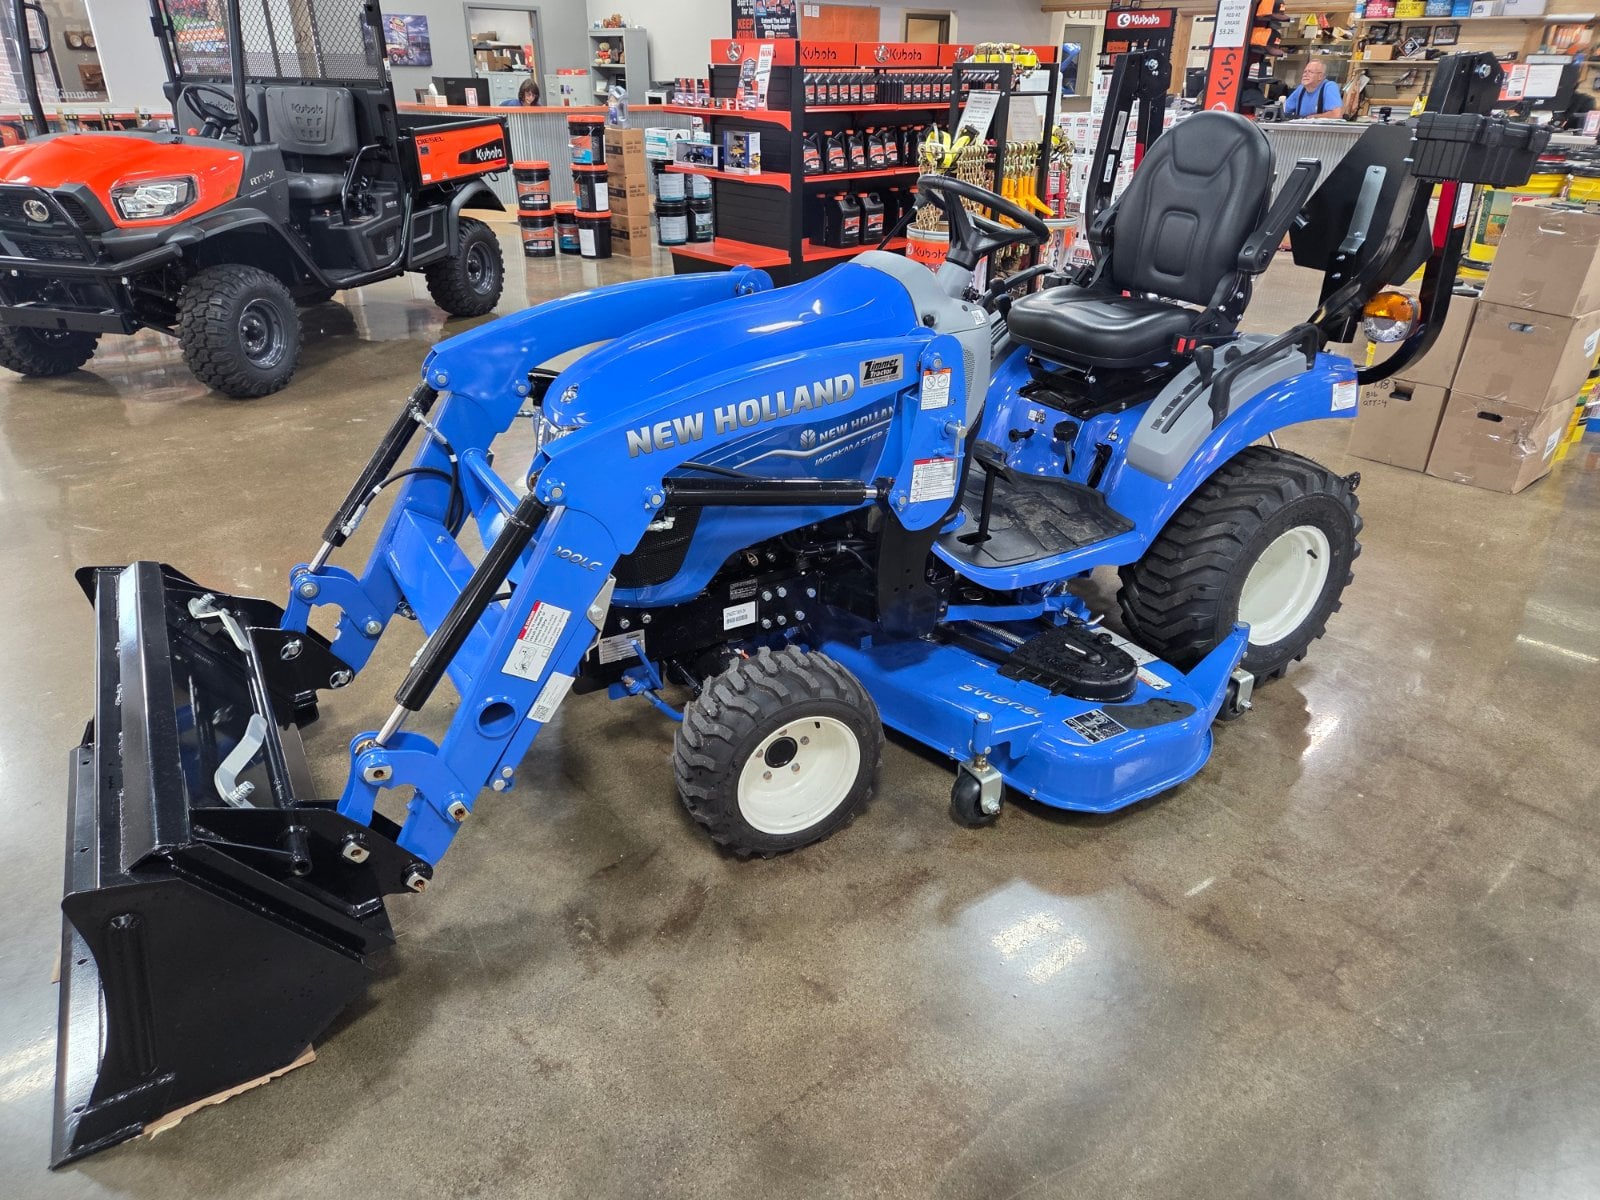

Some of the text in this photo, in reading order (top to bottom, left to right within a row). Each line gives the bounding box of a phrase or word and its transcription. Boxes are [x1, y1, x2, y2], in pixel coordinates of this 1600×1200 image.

[737, 19, 753, 29] KEEP
[1131, 14, 1160, 25] Kubota
[800, 45, 837, 59] Kubota
[889, 45, 922, 60] Kubota
[1216, 48, 1236, 95] Kub
[292, 103, 323, 114] Kubota
[417, 136, 444, 145] DIESEL
[475, 145, 503, 161] Kubota
[250, 170, 275, 186] RTV-X
[626, 373, 855, 458] NEW HOLLAND
[819, 405, 895, 442] NEW HOLLAN
[814, 430, 883, 466] WORKMASTER
